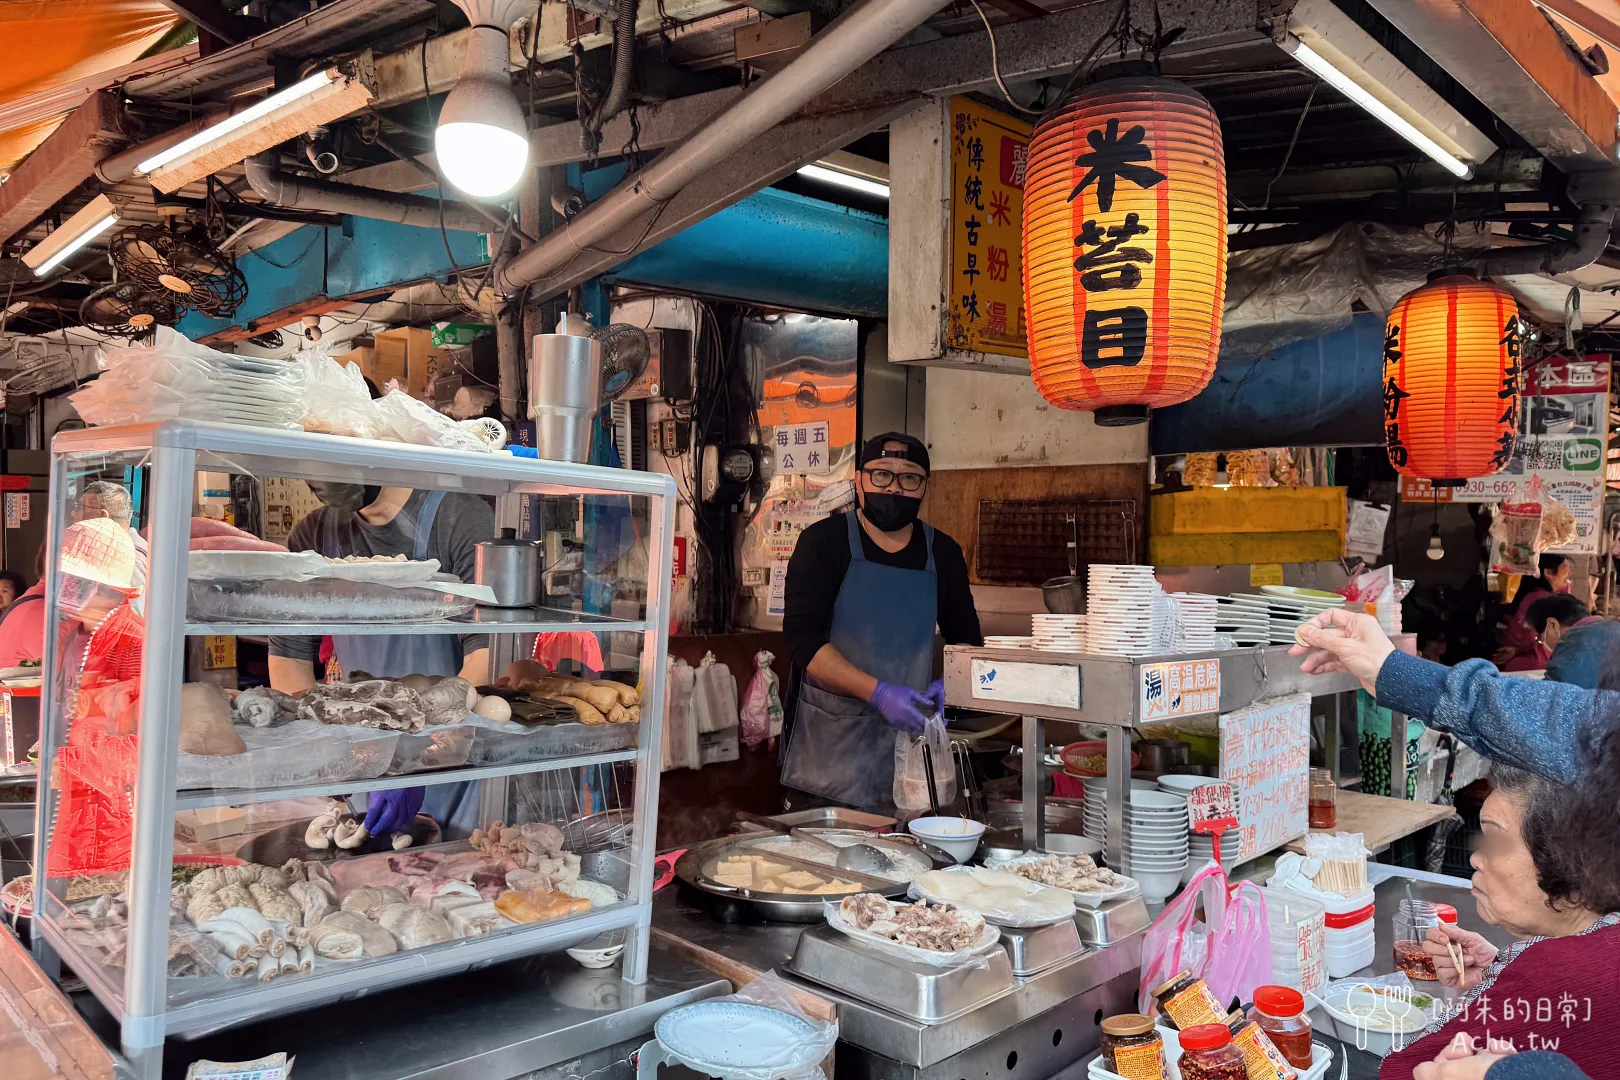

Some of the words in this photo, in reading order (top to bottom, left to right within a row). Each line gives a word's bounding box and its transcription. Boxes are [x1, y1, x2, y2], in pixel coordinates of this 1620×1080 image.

[962, 136, 985, 324] 傳統古早味
[1067, 117, 1168, 369] 米苔目
[986, 190, 1011, 336] 米粉湯
[776, 427, 826, 447] 每週五
[782, 451, 820, 469] 公休
[1567, 448, 1598, 459] LINE
[1169, 662, 1218, 691] 高溫危險
